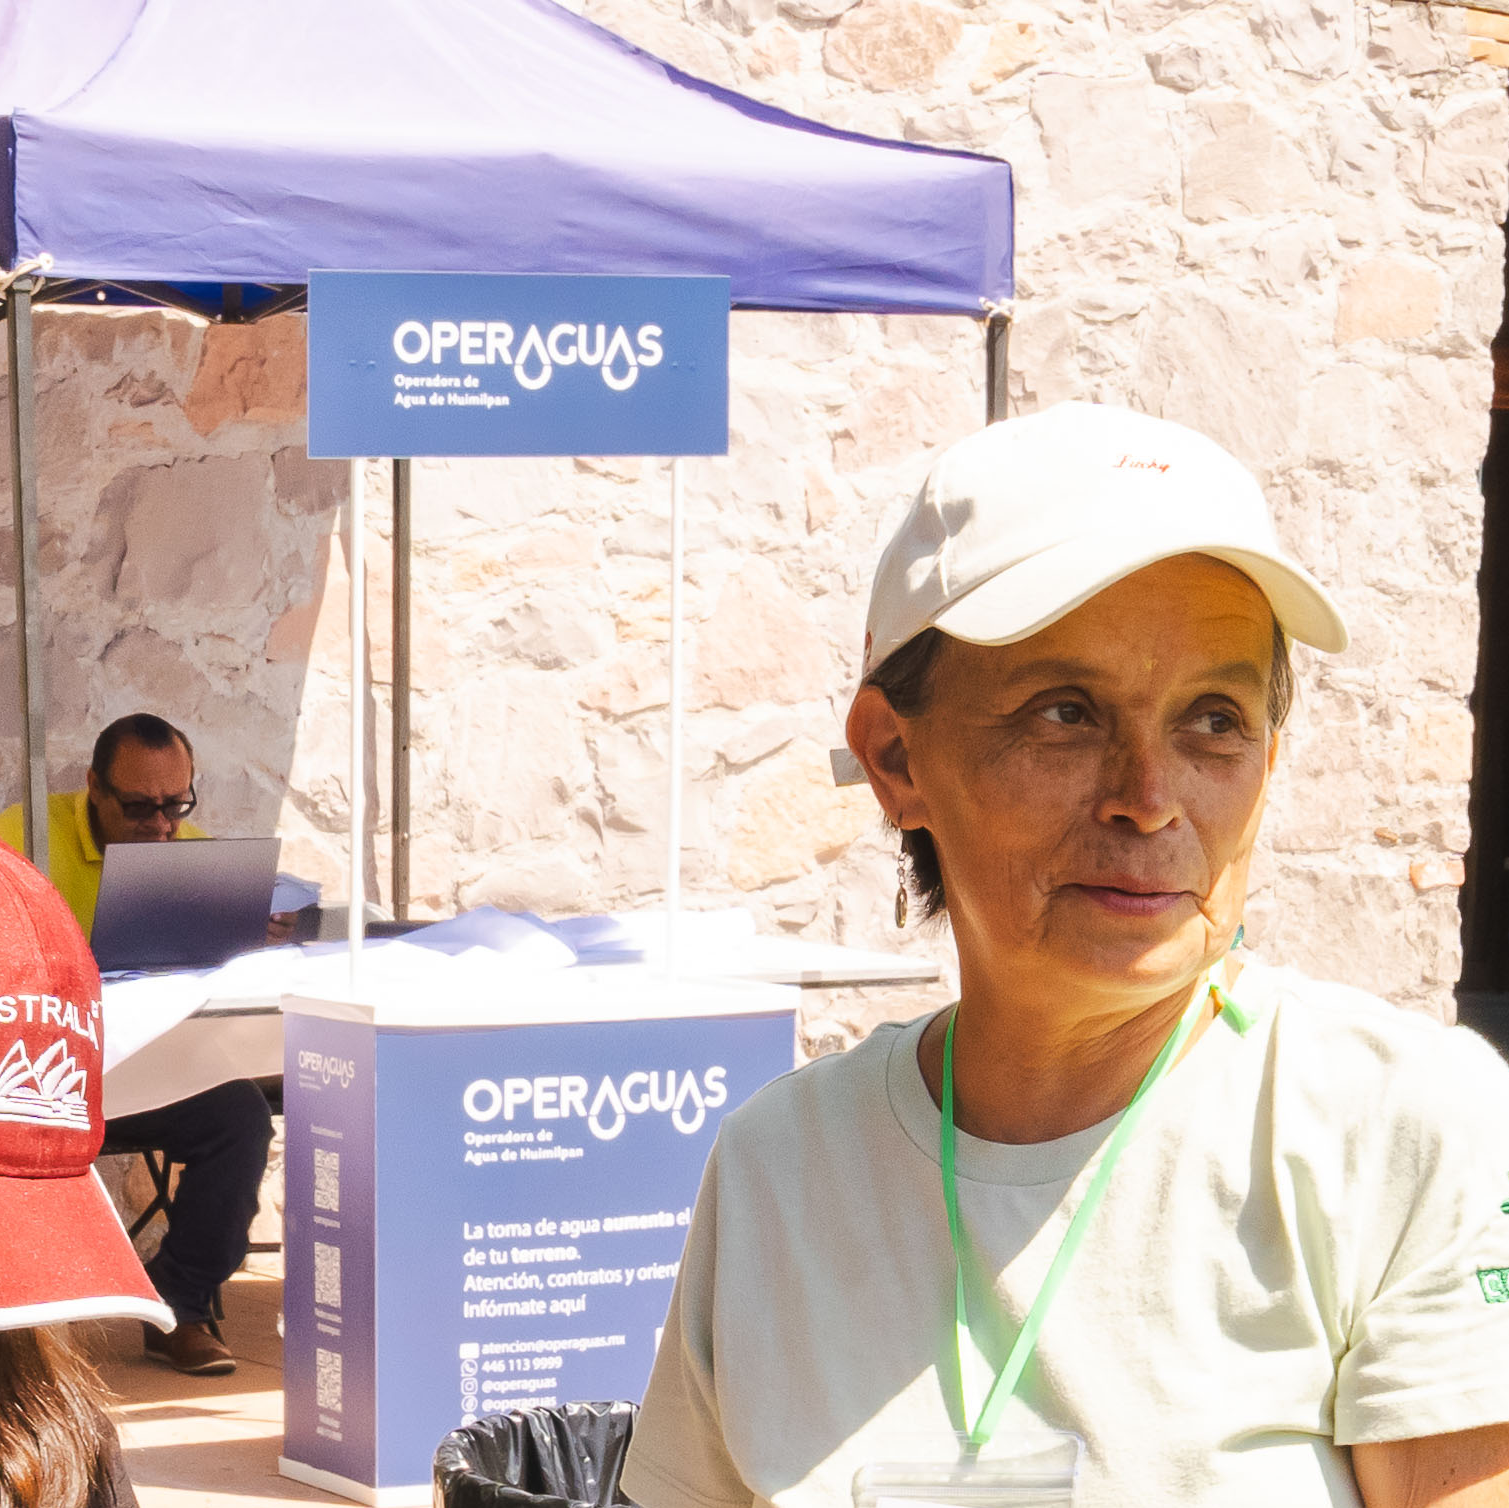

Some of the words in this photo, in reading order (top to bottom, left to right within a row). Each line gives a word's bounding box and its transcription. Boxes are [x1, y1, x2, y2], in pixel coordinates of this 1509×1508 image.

[392, 320, 664, 390] OPERAGUAS
[394, 374, 461, 390] Operadora
[463, 374, 480, 388] de
[394, 392, 427, 409] Agua
[429, 392, 445, 406] de
[447, 392, 510, 409] Huimilpan
[463, 1066, 727, 1140] OPERAGUAS
[464, 1131, 534, 1147] Operadora
[537, 1129, 553, 1142] de
[464, 1150, 498, 1166] Agua
[501, 1149, 517, 1161] de
[520, 1146, 583, 1161] Huimilpan
[463, 1222, 484, 1240] La
[487, 1222, 531, 1238] toma
[535, 1218, 556, 1235] de
[560, 1218, 600, 1238] agua
[603, 1211, 674, 1232] aumenta
[676, 1207, 691, 1225] el
[463, 1248, 486, 1266] de
[490, 1250, 508, 1265] tu
[510, 1246, 581, 1264] terreno.
[463, 1272, 544, 1292] Atención,
[547, 1268, 622, 1288] contratos
[624, 1268, 635, 1286] y
[463, 1299, 547, 1318] Infórmate
[550, 1294, 587, 1316] aquí
[482, 1335, 627, 1354] atencion@operaguas.mx
[482, 1359, 506, 1373] 446
[509, 1358, 530, 1372] 113
[532, 1356, 563, 1371] 9999
[482, 1377, 557, 1393] @operaguas
